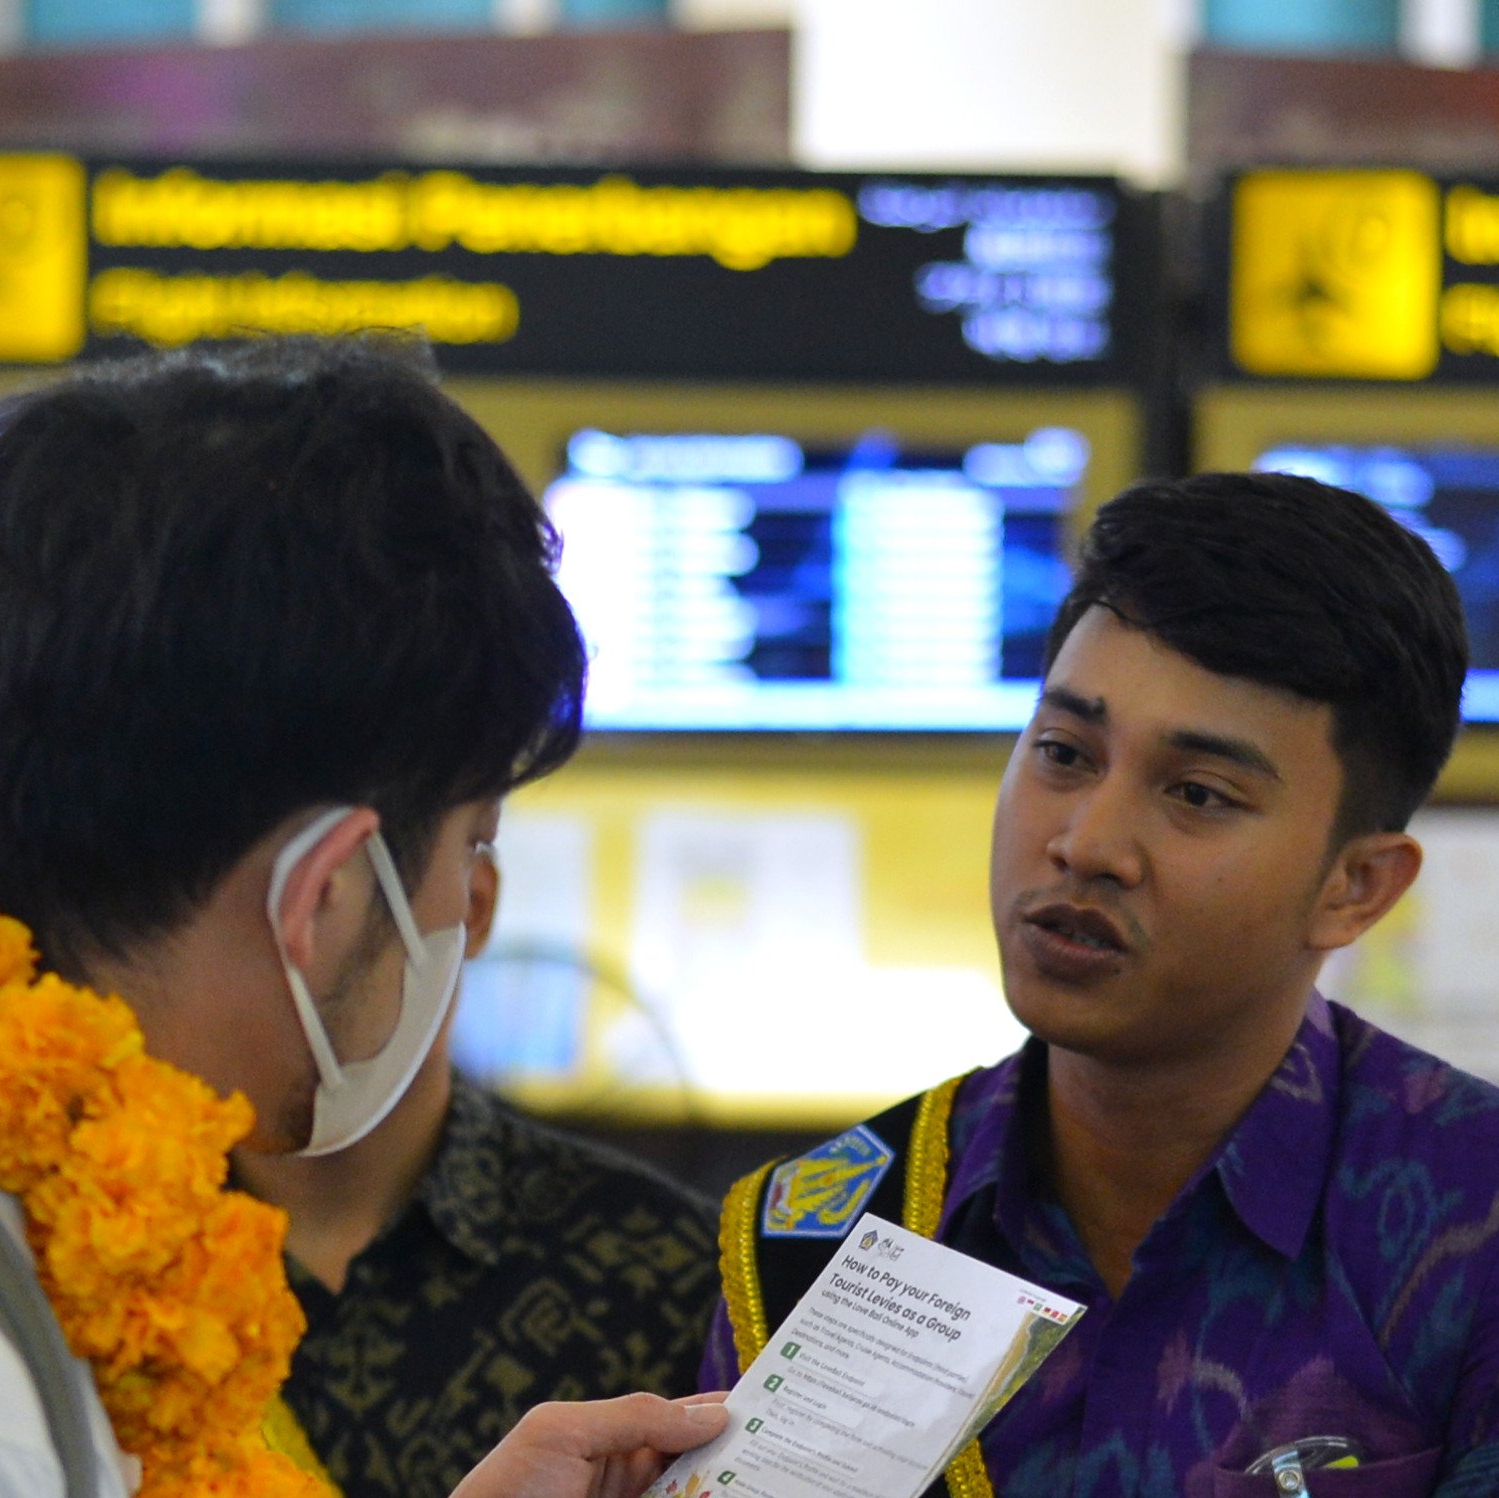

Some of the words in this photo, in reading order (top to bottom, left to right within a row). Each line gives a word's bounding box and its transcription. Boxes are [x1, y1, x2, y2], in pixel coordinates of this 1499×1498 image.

[839, 1254, 870, 1275] How
[864, 1266, 883, 1280] to
[826, 1271, 872, 1299] Tourist
[873, 1271, 905, 1294] Pay
[895, 1282, 930, 1306] your
[864, 1288, 907, 1315] Levies
[898, 1306, 919, 1321] as
[921, 1291, 976, 1325] Foreign
[817, 1288, 843, 1305] using
[838, 1296, 855, 1308] the
[849, 1301, 871, 1315] Love
[866, 1308, 885, 1321] Bali
[879, 1315, 907, 1332] Online
[900, 1325, 921, 1340] App
[913, 1313, 928, 1325] a
[920, 1316, 965, 1344] Group
